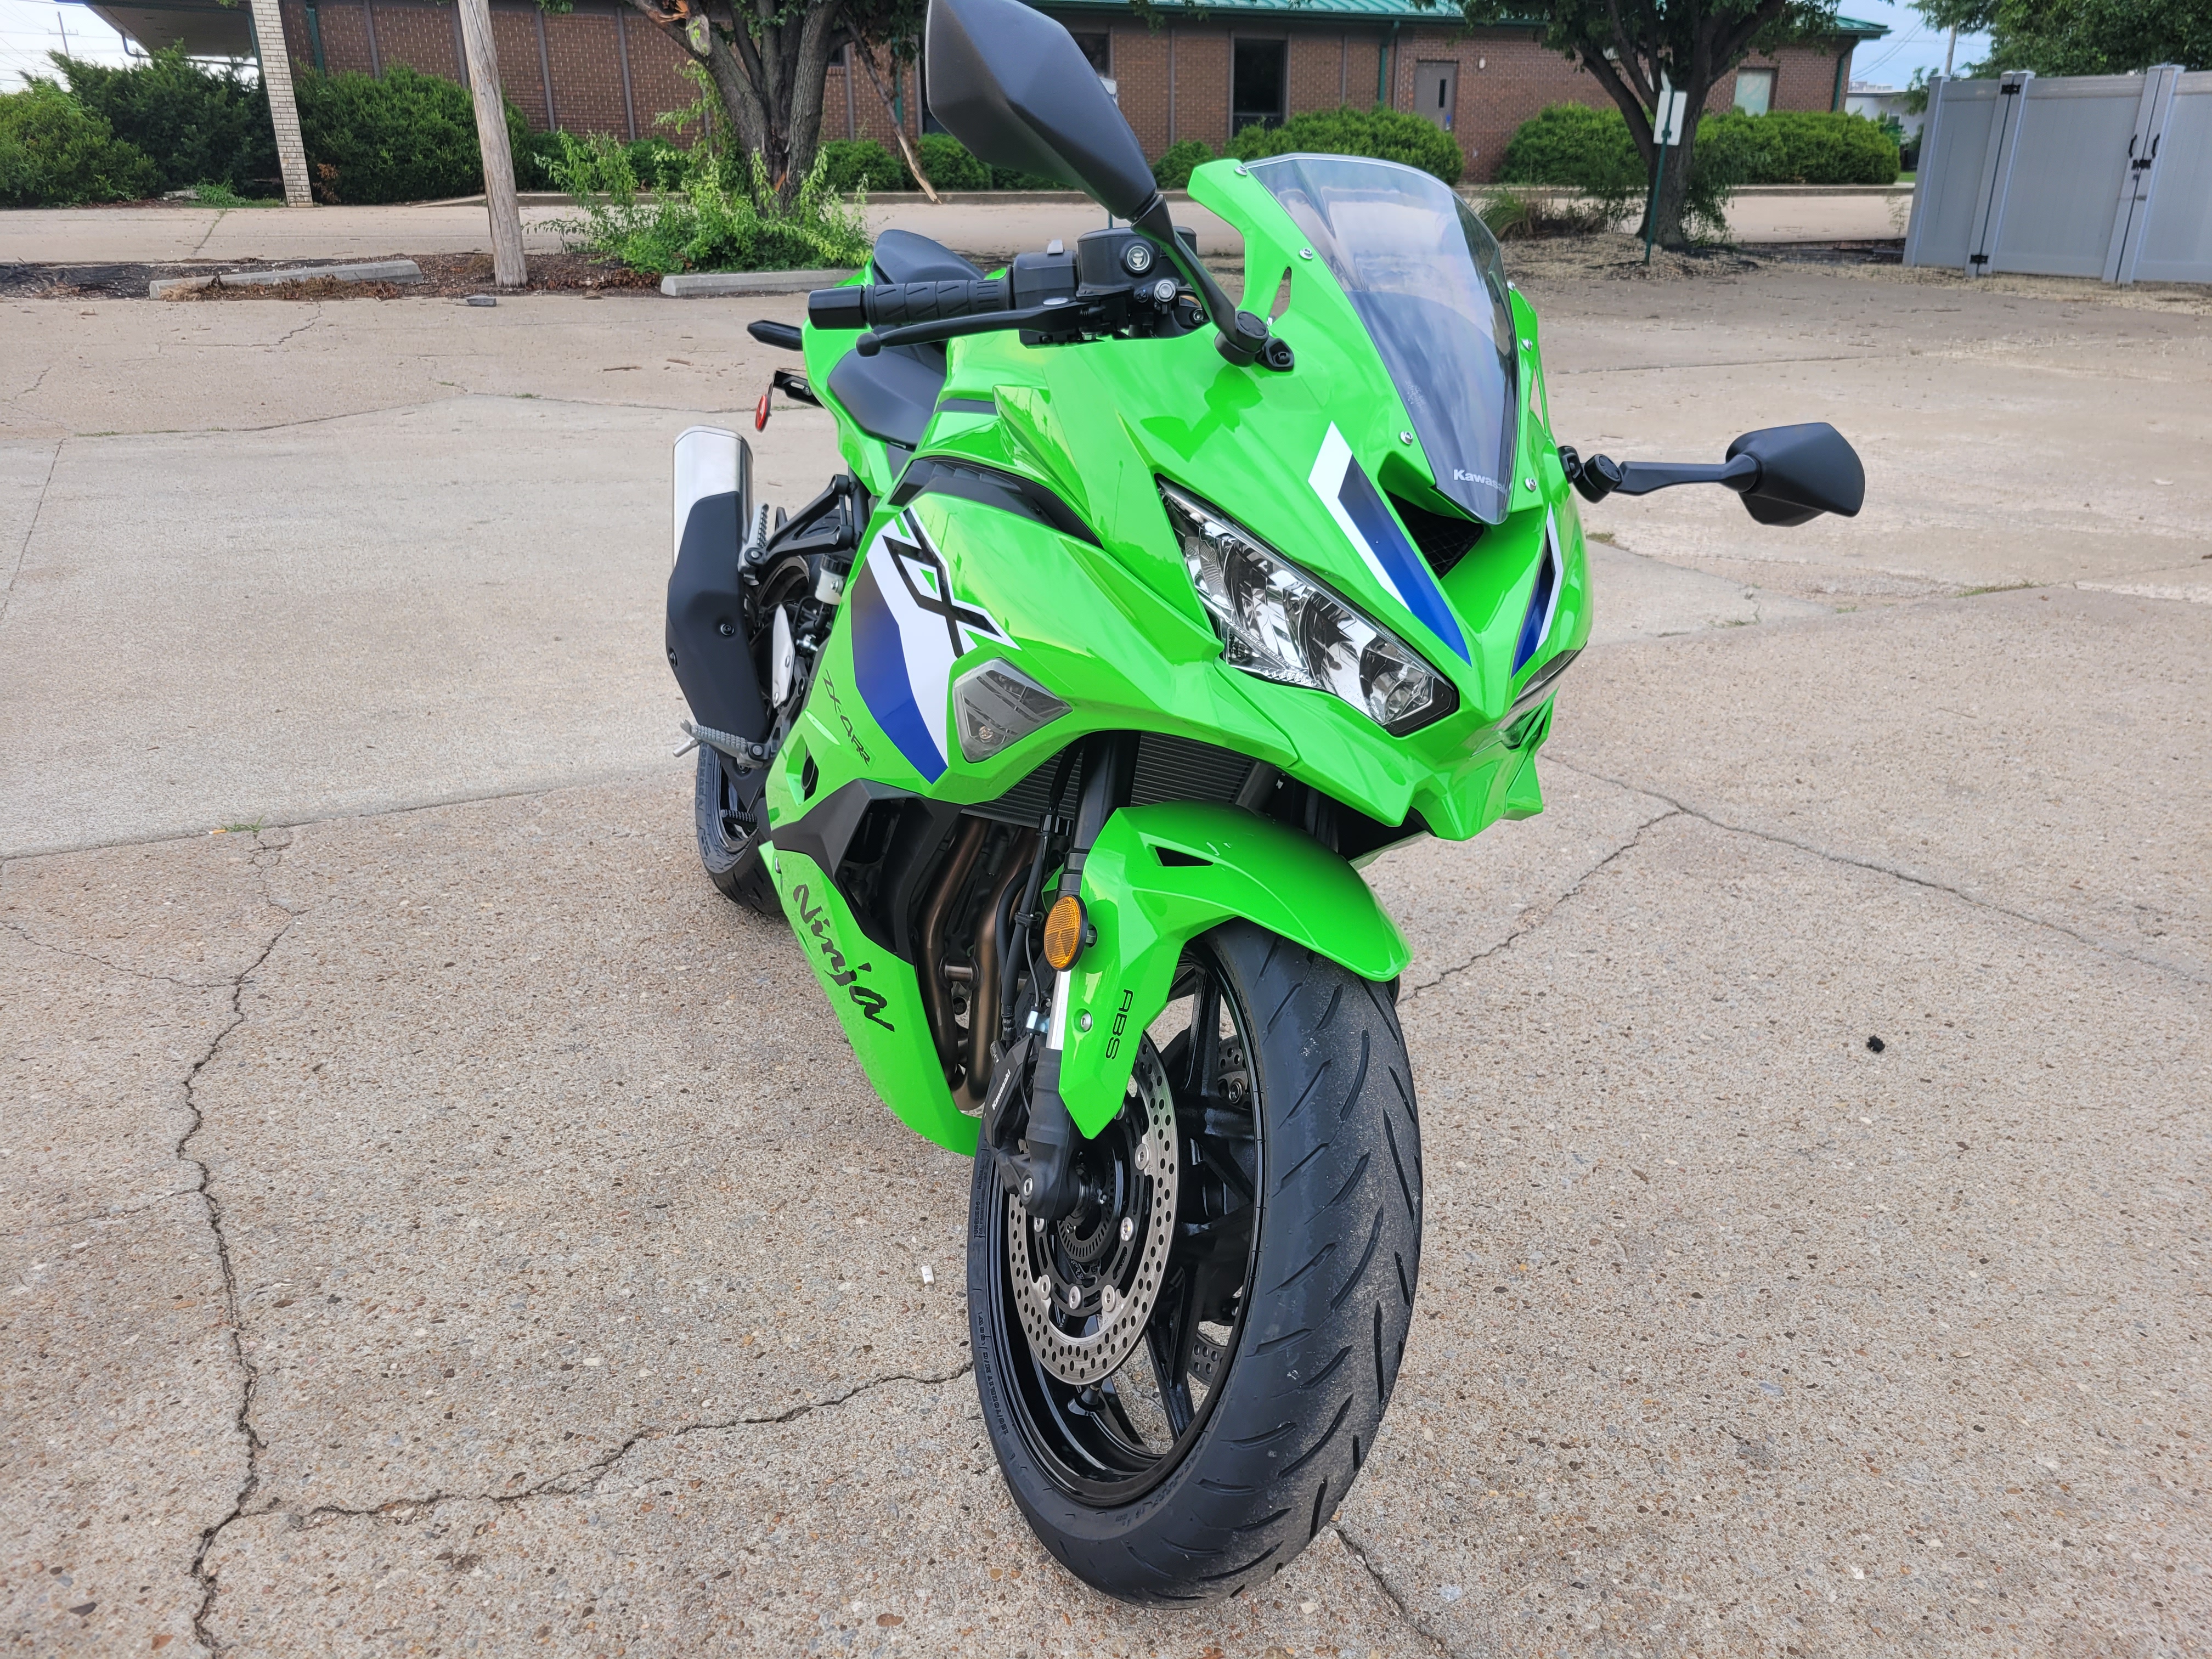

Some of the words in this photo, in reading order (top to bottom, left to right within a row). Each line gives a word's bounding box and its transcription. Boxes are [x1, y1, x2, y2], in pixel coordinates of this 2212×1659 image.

[882, 506, 1003, 659] ZX
[822, 669, 871, 767] ZX-4RR
[793, 883, 895, 1032] Ninja
[1105, 989, 1133, 1060] ABS
[992, 1069, 1011, 1110] Kawasaki
